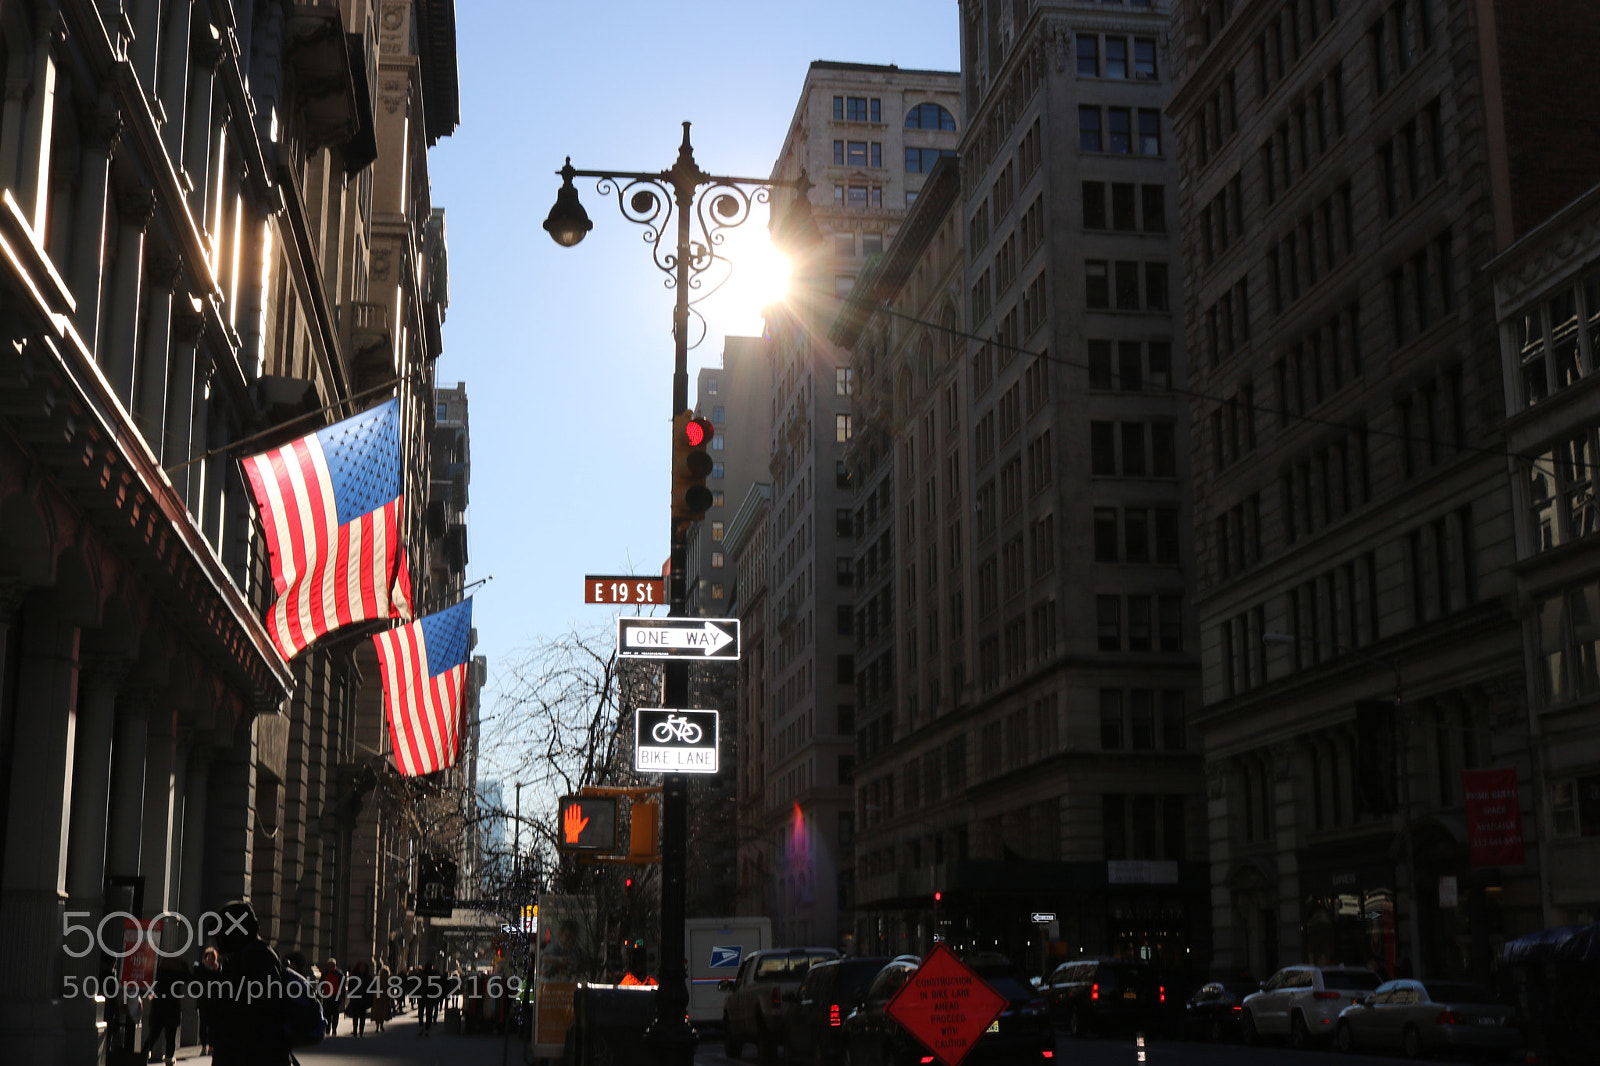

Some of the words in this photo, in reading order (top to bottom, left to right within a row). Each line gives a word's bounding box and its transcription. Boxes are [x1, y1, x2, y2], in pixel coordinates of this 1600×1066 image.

[595, 583, 603, 602] E
[611, 583, 628, 602] 19
[636, 583, 653, 602] St
[636, 631, 669, 645] ONE
[686, 632, 720, 646] WAY
[641, 751, 670, 764] BIKE
[678, 752, 712, 765] LANE
[916, 976, 972, 988] CONSTRUCTION
[920, 991, 928, 999] IN
[931, 990, 948, 999] BIKE
[952, 989, 970, 998] LANE
[935, 1002, 960, 1011] AHEAD
[931, 1015, 966, 1024] PROCEED
[941, 1027, 959, 1036] WITH
[935, 1039, 967, 1049] CAUTION
